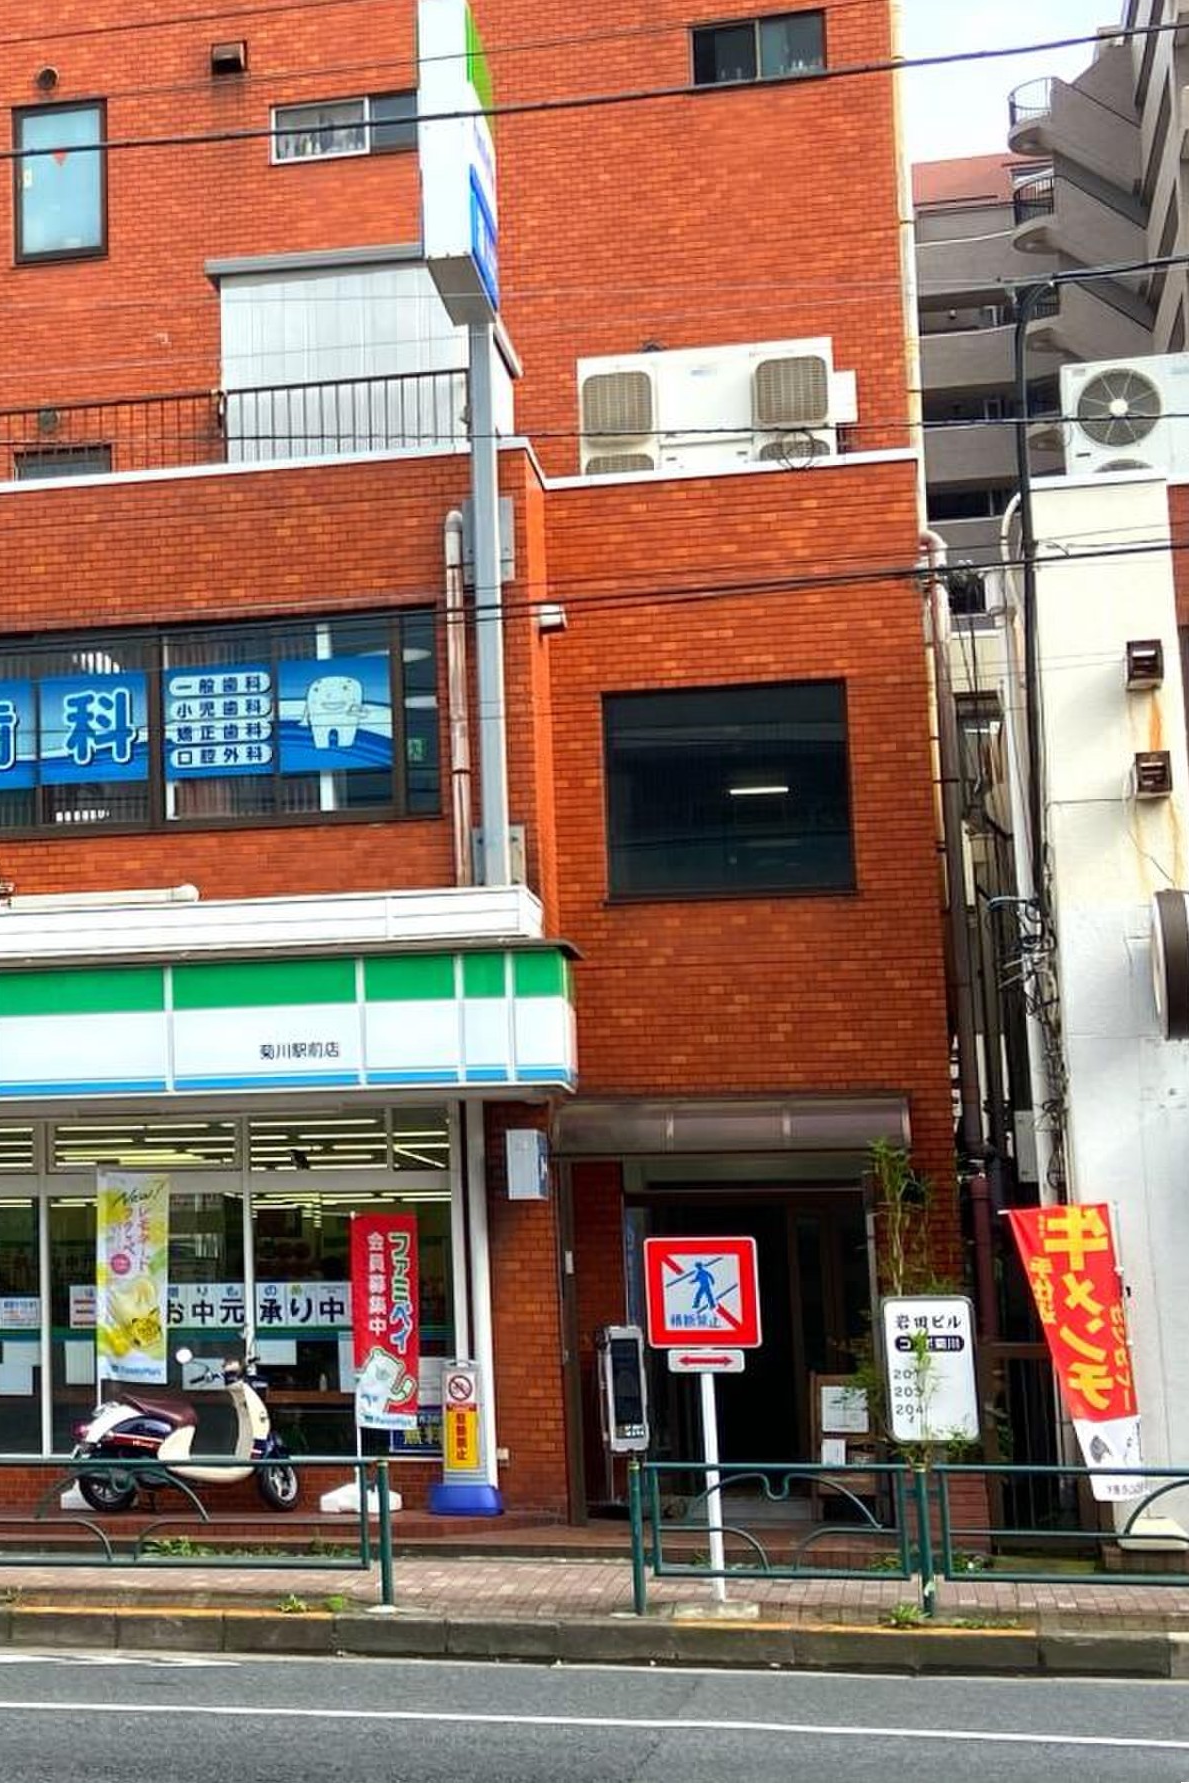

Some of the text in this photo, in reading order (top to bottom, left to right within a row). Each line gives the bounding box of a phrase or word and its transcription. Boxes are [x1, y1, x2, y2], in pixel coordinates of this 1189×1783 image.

[176, 676, 260, 693] 一般歯科
[177, 699, 260, 718] 小児歯科
[177, 722, 261, 742] 矯正歯科
[178, 746, 262, 765] 口腔外科
[260, 1041, 339, 1060] 菊川駅前店
[368, 1232, 387, 1336] 会員募集中
[388, 1232, 413, 1354] ファミペイ
[895, 1314, 962, 1330] 岩田ビル
